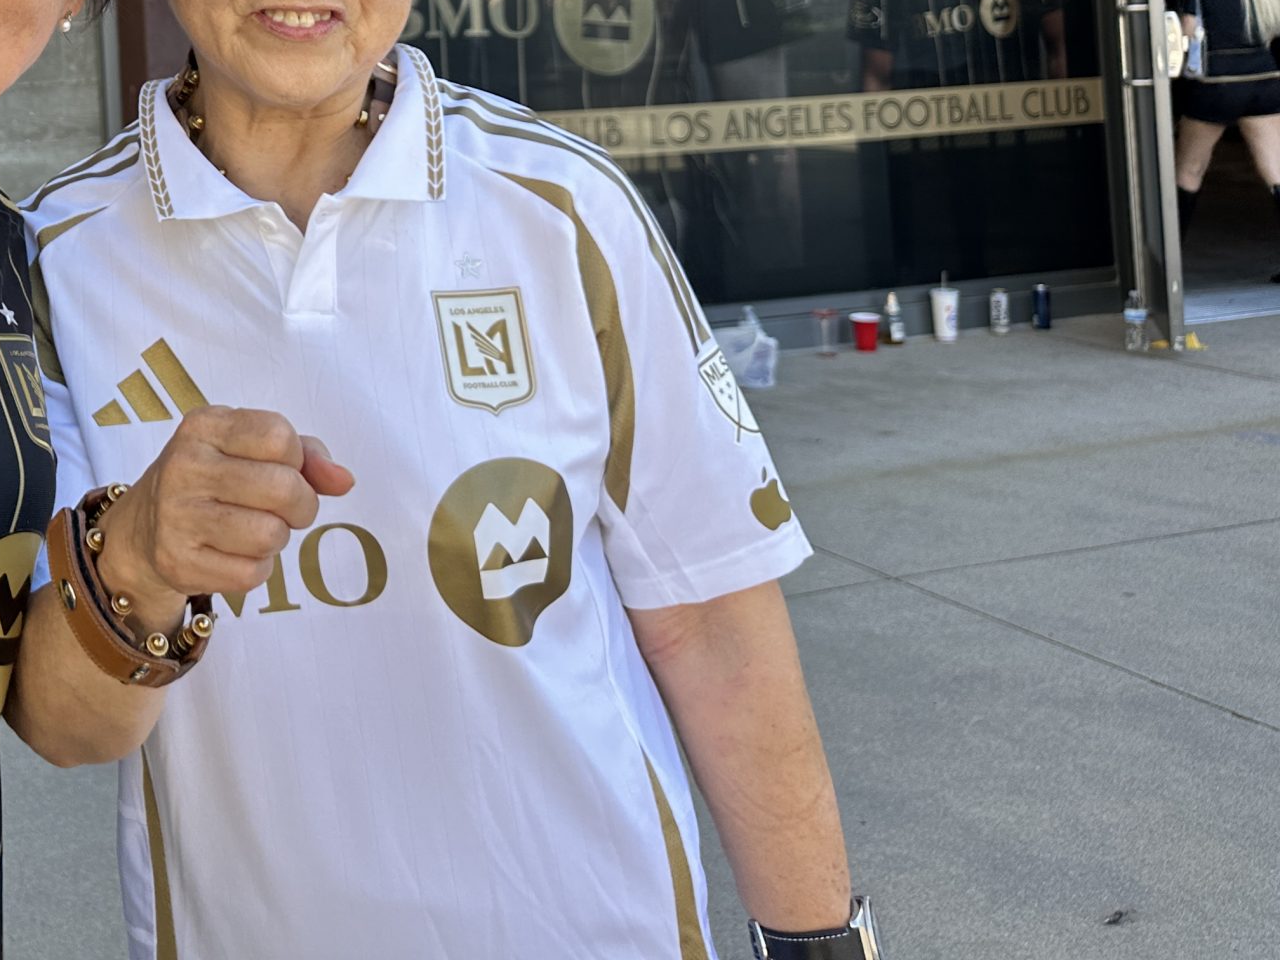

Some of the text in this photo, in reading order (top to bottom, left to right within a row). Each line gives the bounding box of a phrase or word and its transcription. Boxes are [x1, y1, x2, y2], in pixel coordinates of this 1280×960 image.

[650, 109, 713, 145] LOS
[723, 101, 853, 142] ANGELES
[861, 90, 1015, 130] FOOTBALL
[1022, 85, 1091, 119] CLUB
[702, 355, 730, 386] MLS
